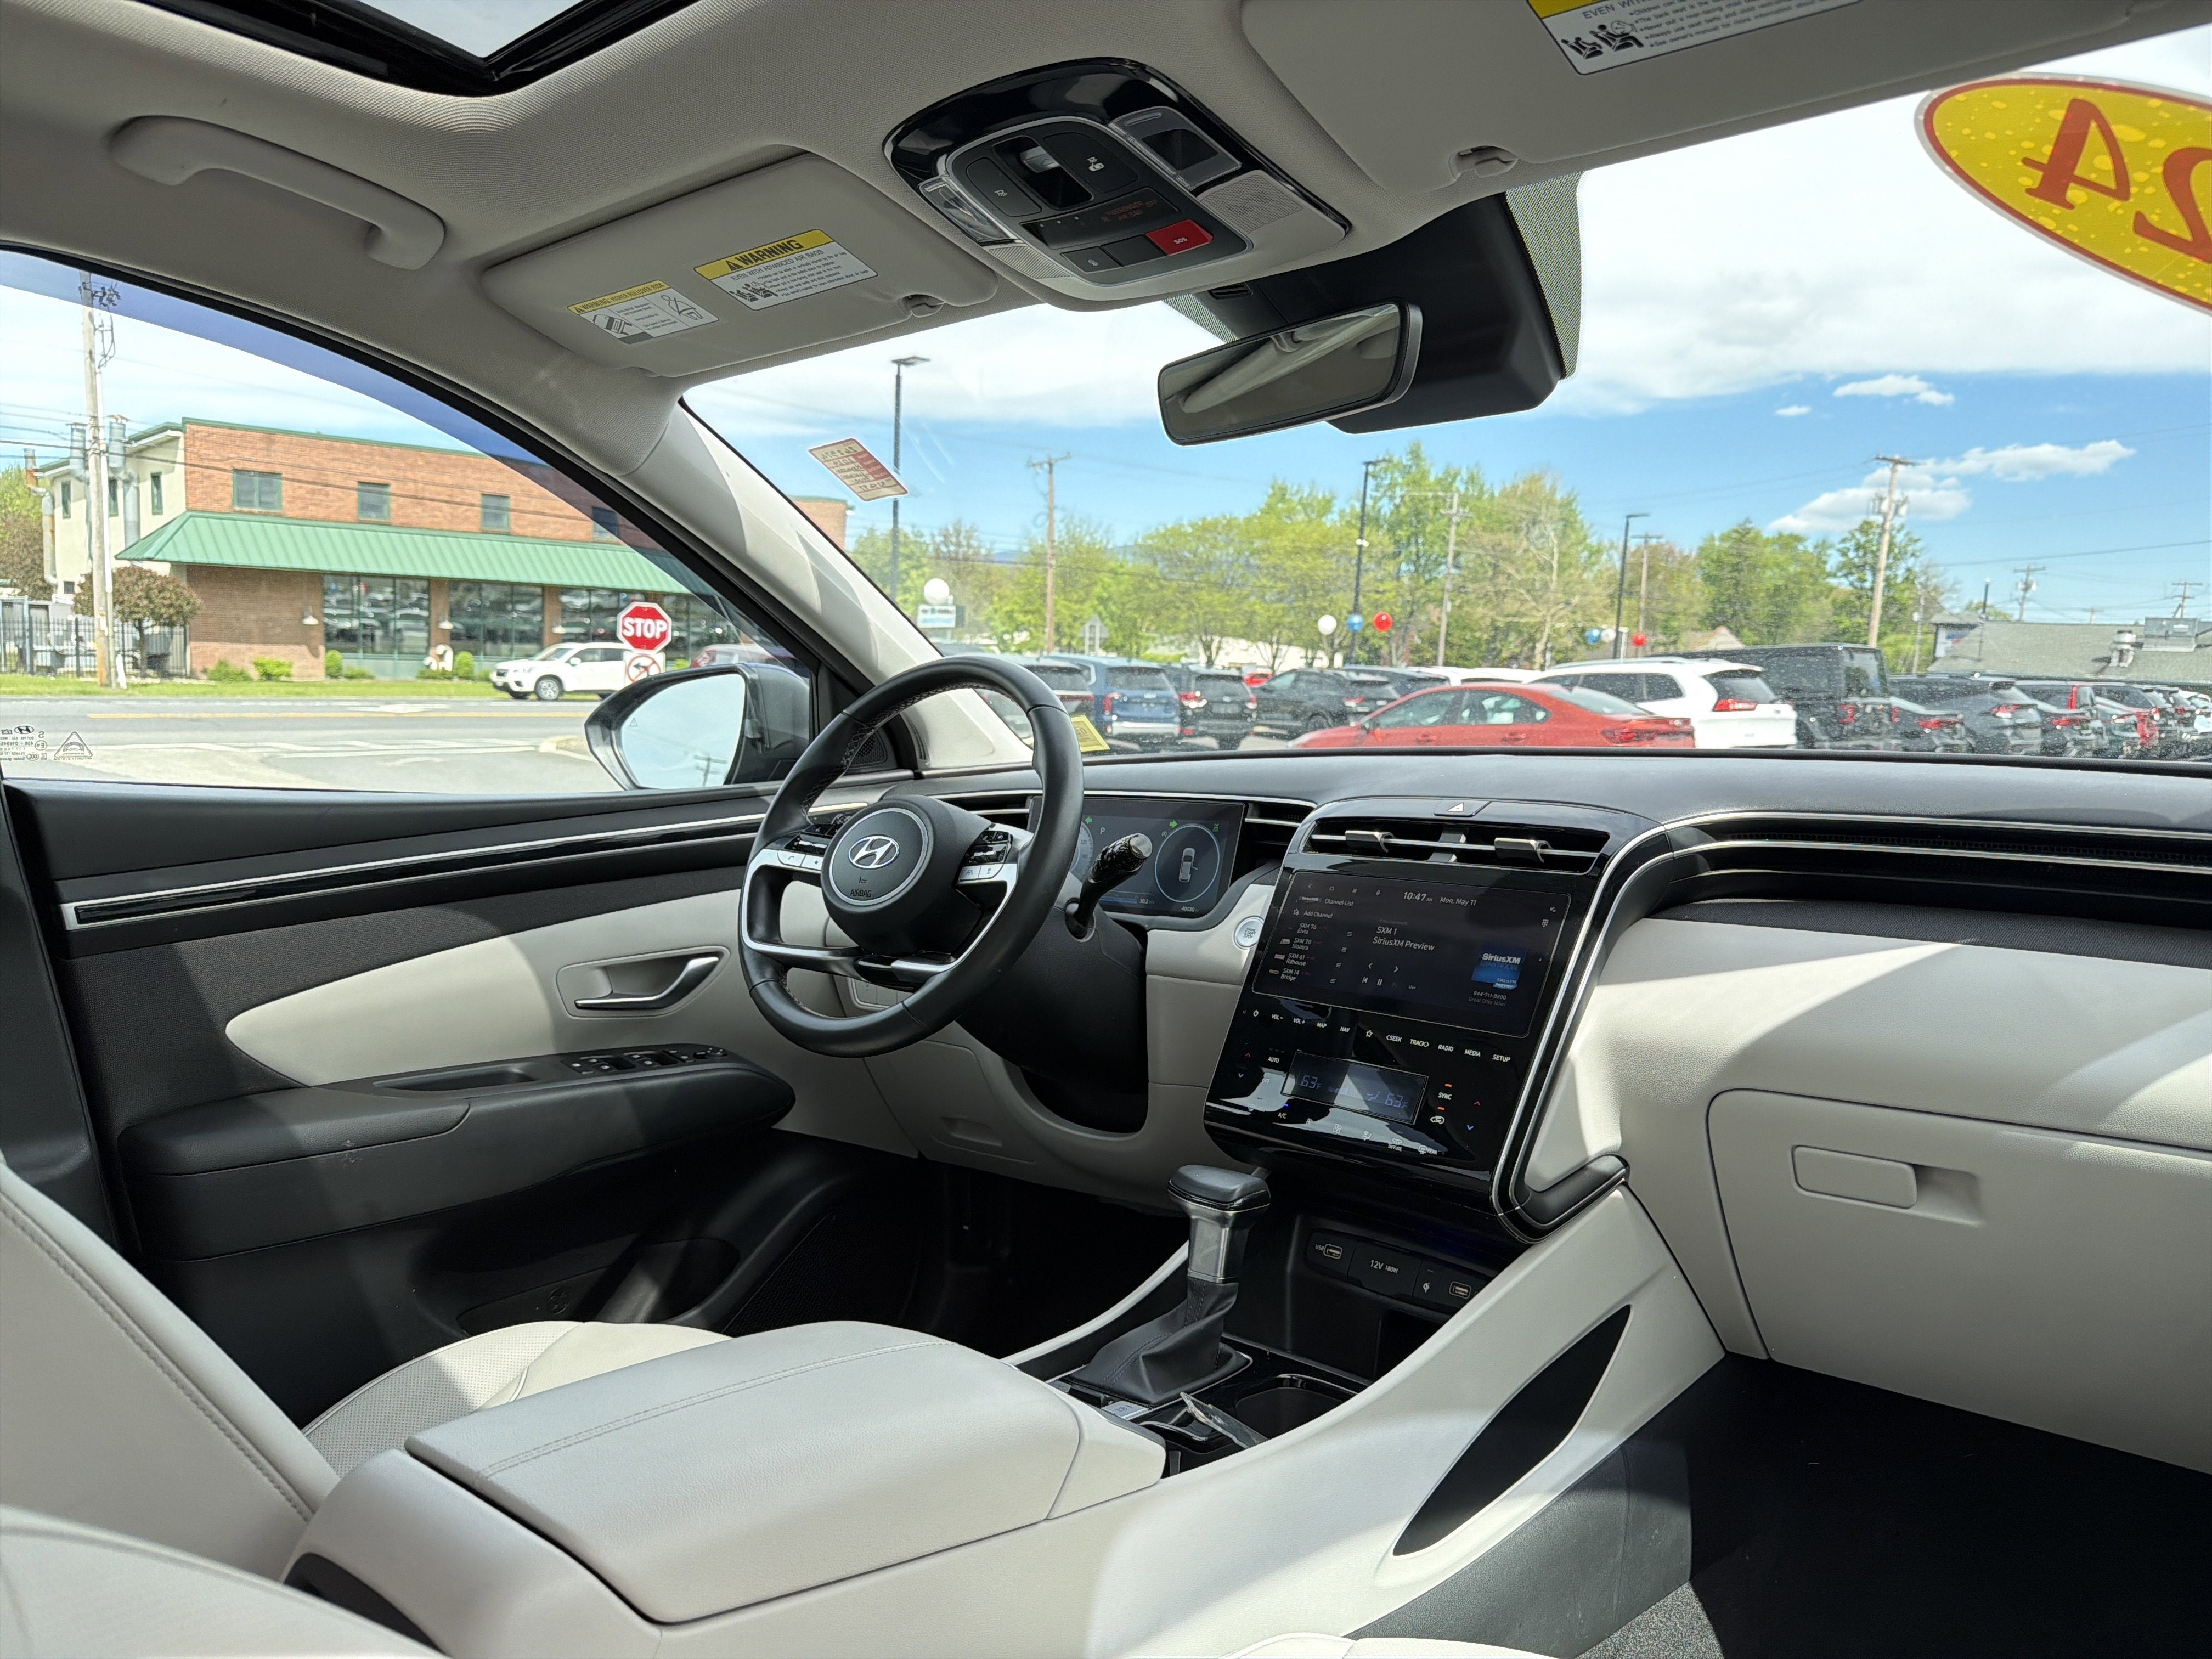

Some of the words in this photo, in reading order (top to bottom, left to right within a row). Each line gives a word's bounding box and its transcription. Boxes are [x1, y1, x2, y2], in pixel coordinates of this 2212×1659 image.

[1582, 4, 1616, 20] EVEN
[735, 239, 804, 266] WARNING
[730, 273, 746, 281] EVEN
[748, 268, 764, 276] WITH
[763, 258, 794, 271] ADVANCED
[805, 249, 825, 258] BAGS
[580, 298, 612, 311] WARNING:
[623, 616, 668, 639] STOP
[850, 889, 872, 898] AIRBAG
[1403, 891, 1427, 901] 10:47
[1455, 898, 1469, 906] May
[1376, 926, 1393, 935] SXM
[1372, 936, 1404, 947] SiriusXM
[1404, 940, 1435, 951] Preview
[1481, 953, 1521, 964] SiriusXM
[1280, 974, 1296, 982] Bridge
[1438, 1044, 1454, 1052] RADIO
[1464, 1049, 1481, 1057] MEDIA
[1492, 1054, 1511, 1063] SETUP
[1438, 1092, 1452, 1101] SYNC
[1370, 1260, 1384, 1270] 12V
[1385, 1265, 1399, 1274] 180W
